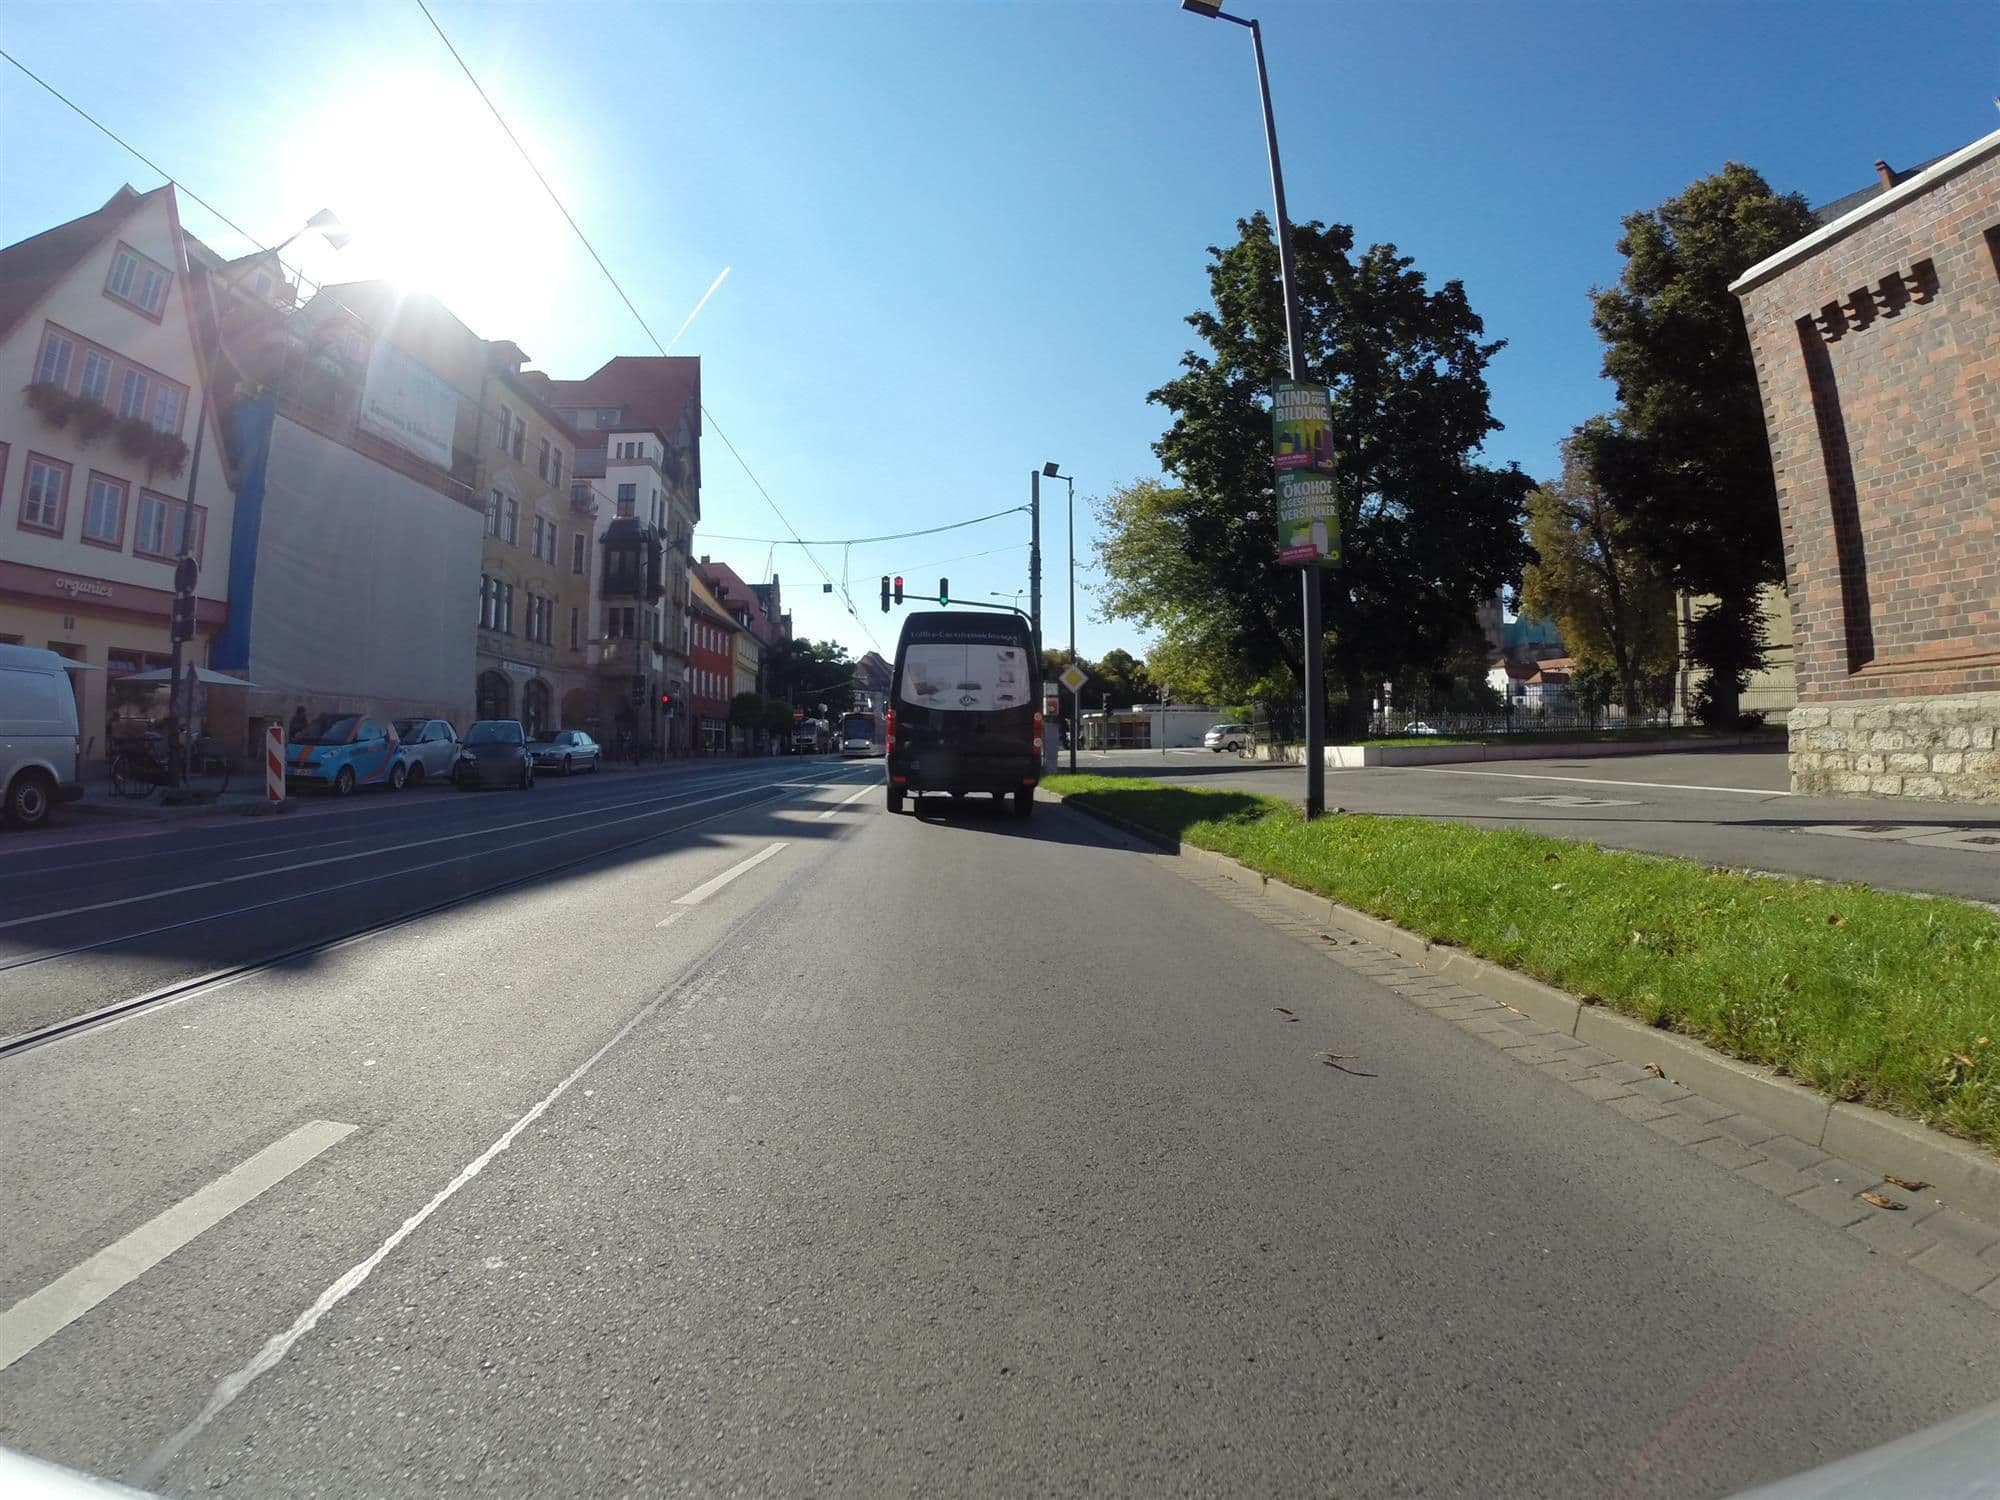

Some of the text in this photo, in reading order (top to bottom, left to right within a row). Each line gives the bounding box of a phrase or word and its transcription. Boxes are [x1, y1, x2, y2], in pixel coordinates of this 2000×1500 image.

[1275, 391, 1310, 407] KIND
[1275, 406, 1330, 422] BILDUNG.
[1283, 480, 1332, 499] ÖKOHOF
[56, 577, 113, 597] organics
